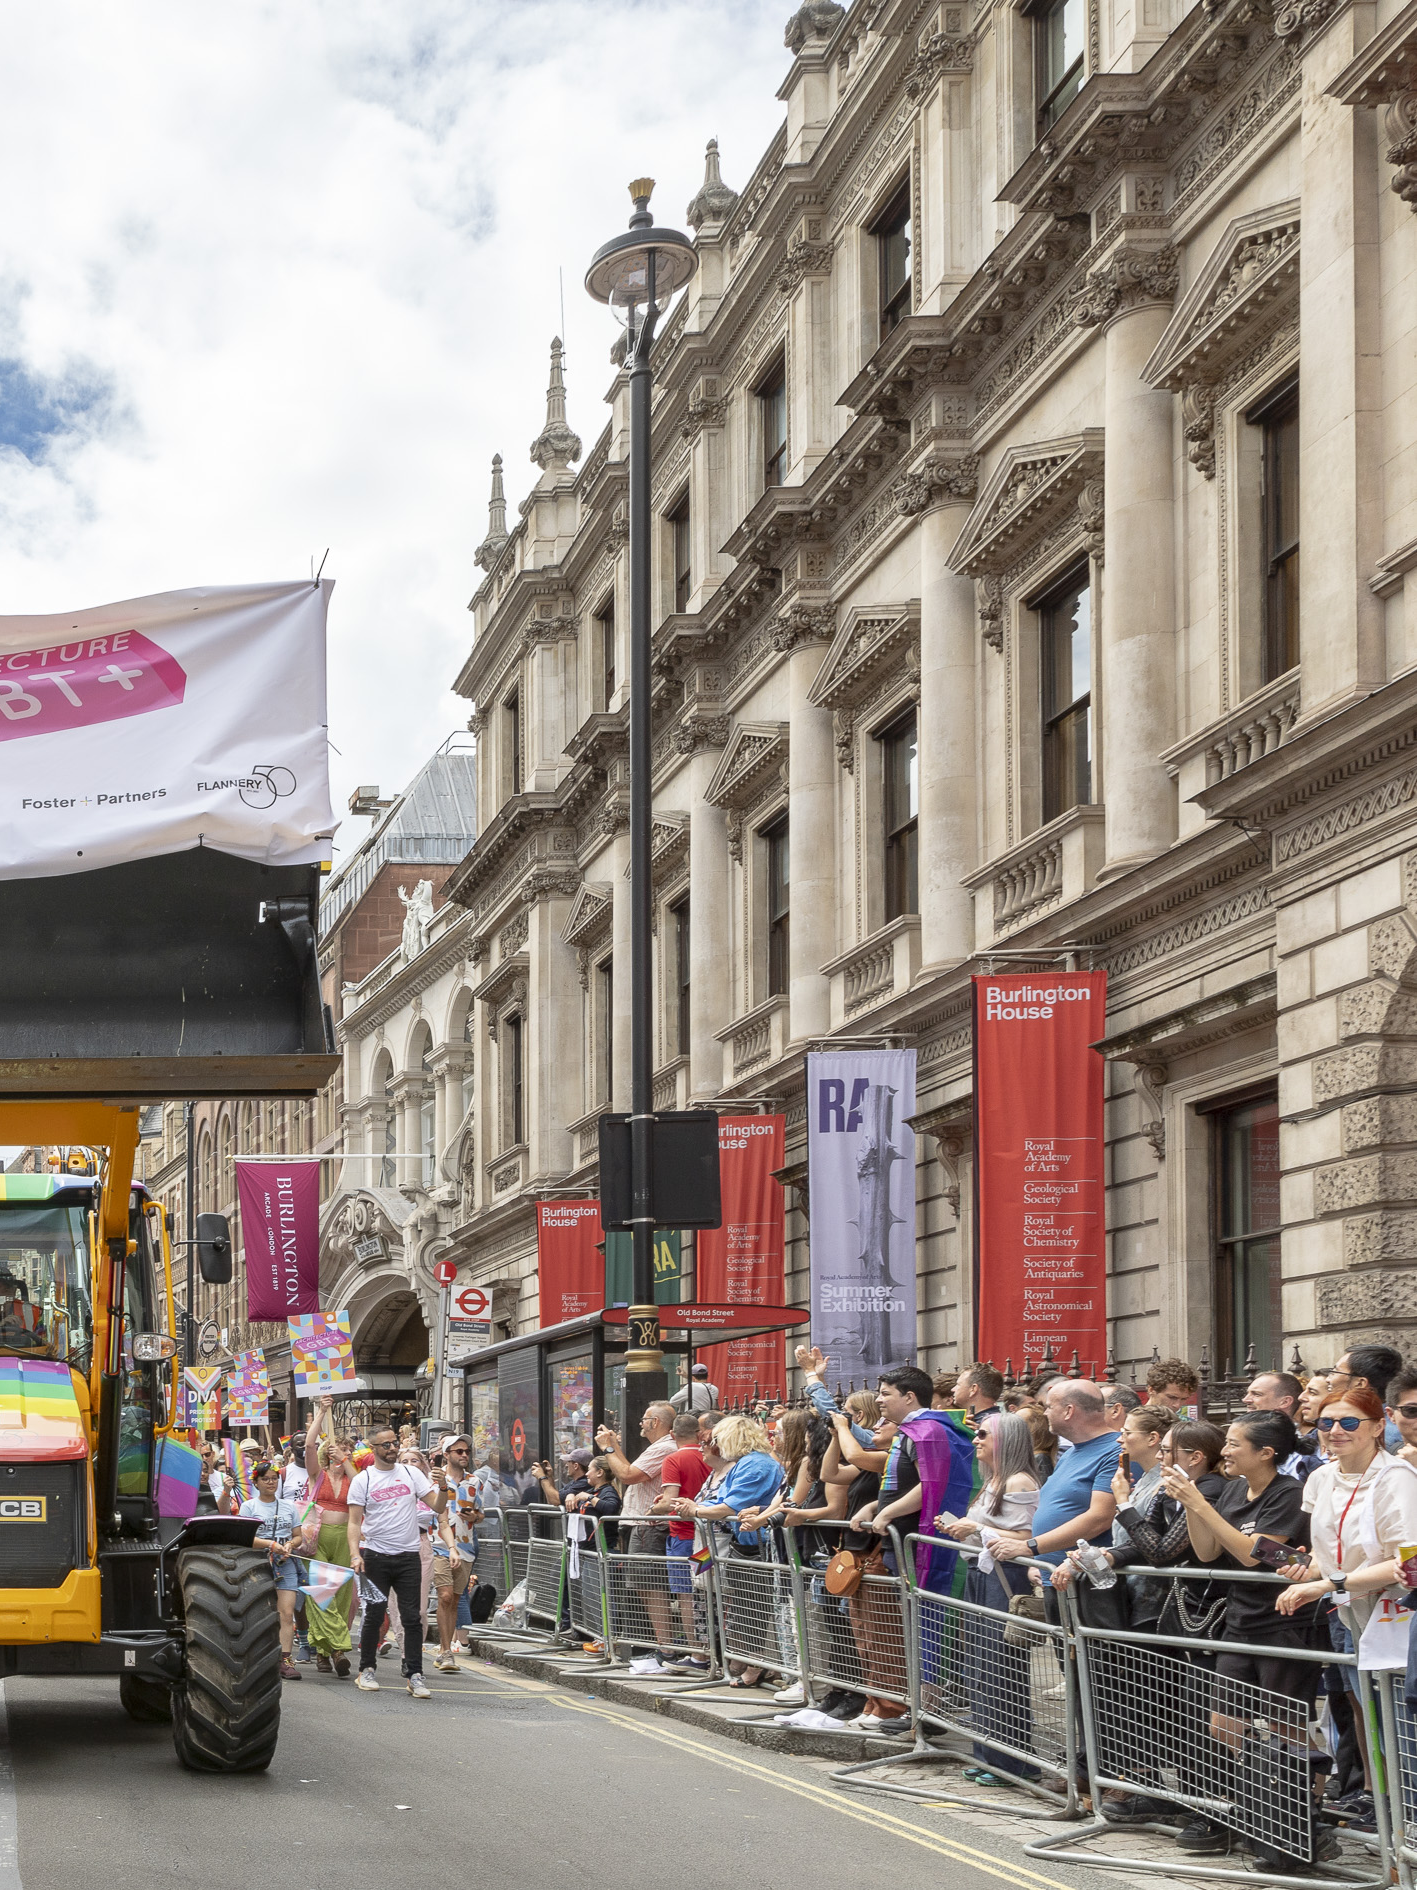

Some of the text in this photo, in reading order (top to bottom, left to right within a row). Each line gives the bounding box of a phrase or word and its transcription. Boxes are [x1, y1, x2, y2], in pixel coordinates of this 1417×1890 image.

[197, 779, 263, 791] FLANNERY
[22, 798, 76, 809] Foster
[97, 787, 167, 805] Partners
[986, 986, 1090, 1006] Burlington
[987, 1004, 1053, 1021] House
[718, 1124, 773, 1138] rlington
[1024, 1141, 1054, 1154] Royal
[1025, 1151, 1071, 1164] Academy
[1024, 1161, 1060, 1172] of Arts
[1023, 1183, 1079, 1196] Geological
[264, 1192, 272, 1218] ARCADE
[1023, 1194, 1061, 1206] Society
[542, 1207, 597, 1218] Burlington
[542, 1218, 578, 1227] House
[1024, 1215, 1054, 1228] Royal
[727, 1226, 748, 1235] Royal
[1023, 1225, 1074, 1238] Society of
[267, 1227, 276, 1256] LONDON
[276, 1177, 300, 1307] BURLINGTON
[728, 1234, 760, 1243] Academy
[1023, 1236, 1079, 1249] Chemistry
[727, 1256, 765, 1265] Geological
[1023, 1257, 1075, 1270] Society of
[440, 1264, 451, 1280] L
[727, 1264, 753, 1273] Society
[1024, 1268, 1084, 1280] Antiquaries
[727, 1280, 748, 1289] Royal
[820, 1283, 893, 1298] Summer
[727, 1288, 752, 1296] Society
[1024, 1290, 1054, 1302] Royal
[727, 1295, 765, 1304] Chemistry
[820, 1298, 906, 1312] Exhibition
[1024, 1300, 1093, 1311] Astronomical
[1023, 1311, 1061, 1323] Society
[1024, 1332, 1067, 1342] Linnean
[298, 1336, 342, 1351] LGBT+
[1023, 1343, 1062, 1355] Socity
[728, 1372, 754, 1380] Society
[188, 1391, 218, 1403] DIVA
[232, 1386, 262, 1397] LGBT+
[373, 1488, 407, 1501] LGBT+
